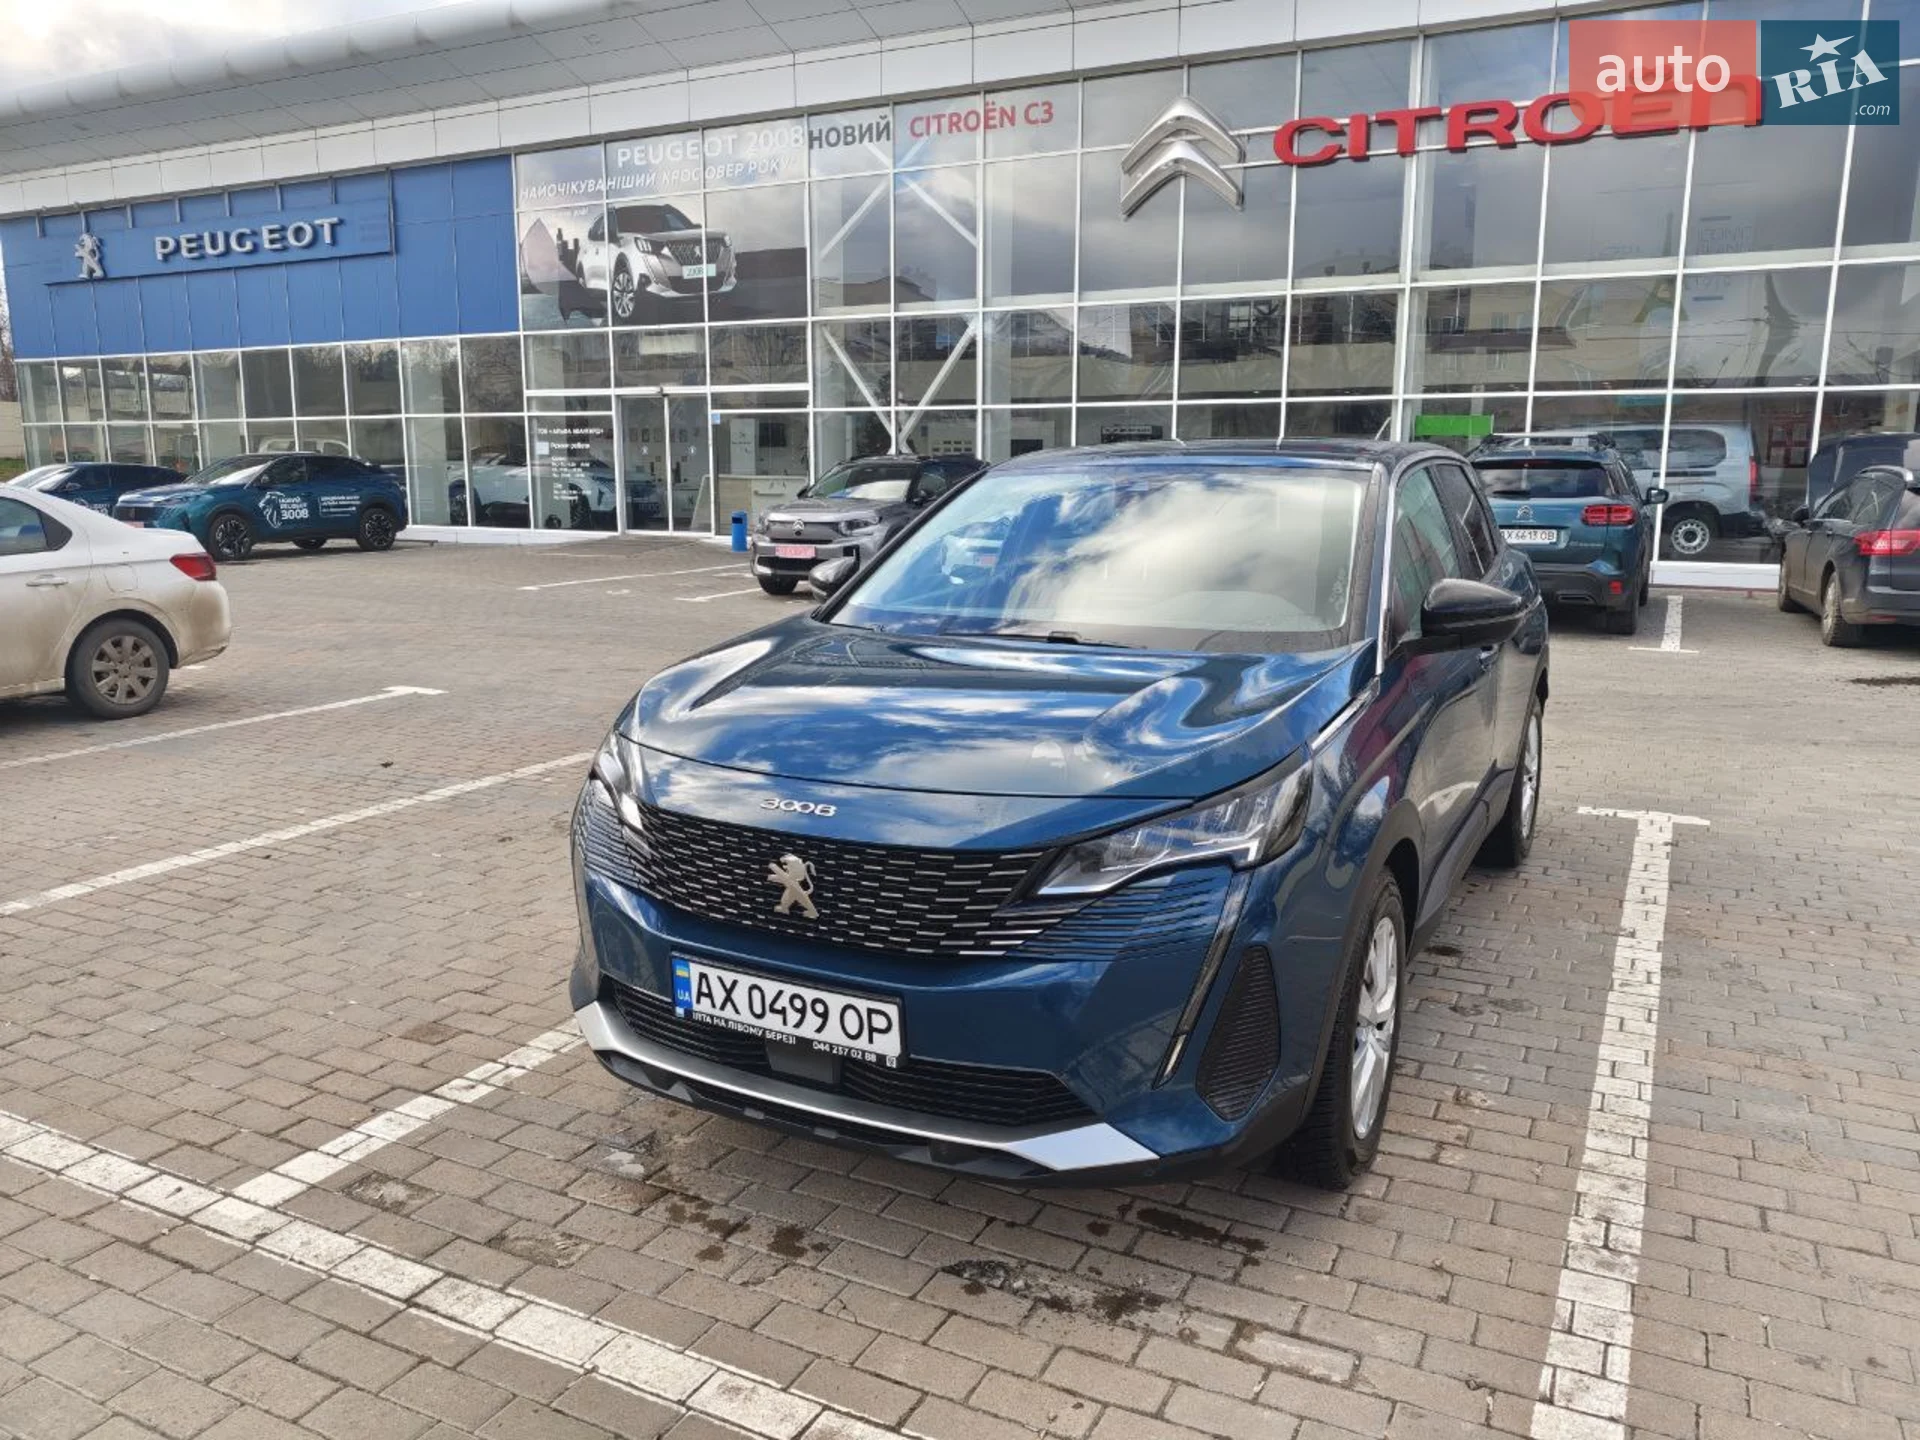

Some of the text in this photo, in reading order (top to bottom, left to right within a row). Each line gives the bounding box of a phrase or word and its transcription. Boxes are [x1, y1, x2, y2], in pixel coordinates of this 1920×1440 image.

[616, 125, 804, 168] PEUGEOT 2008
[808, 100, 1054, 150] НОВИЙ CITROËN C3
[154, 216, 341, 261] PEUGEOT
[281, 508, 310, 520] 3008
[760, 797, 838, 817] 3008
[695, 971, 893, 1045] AX 0499 OP
